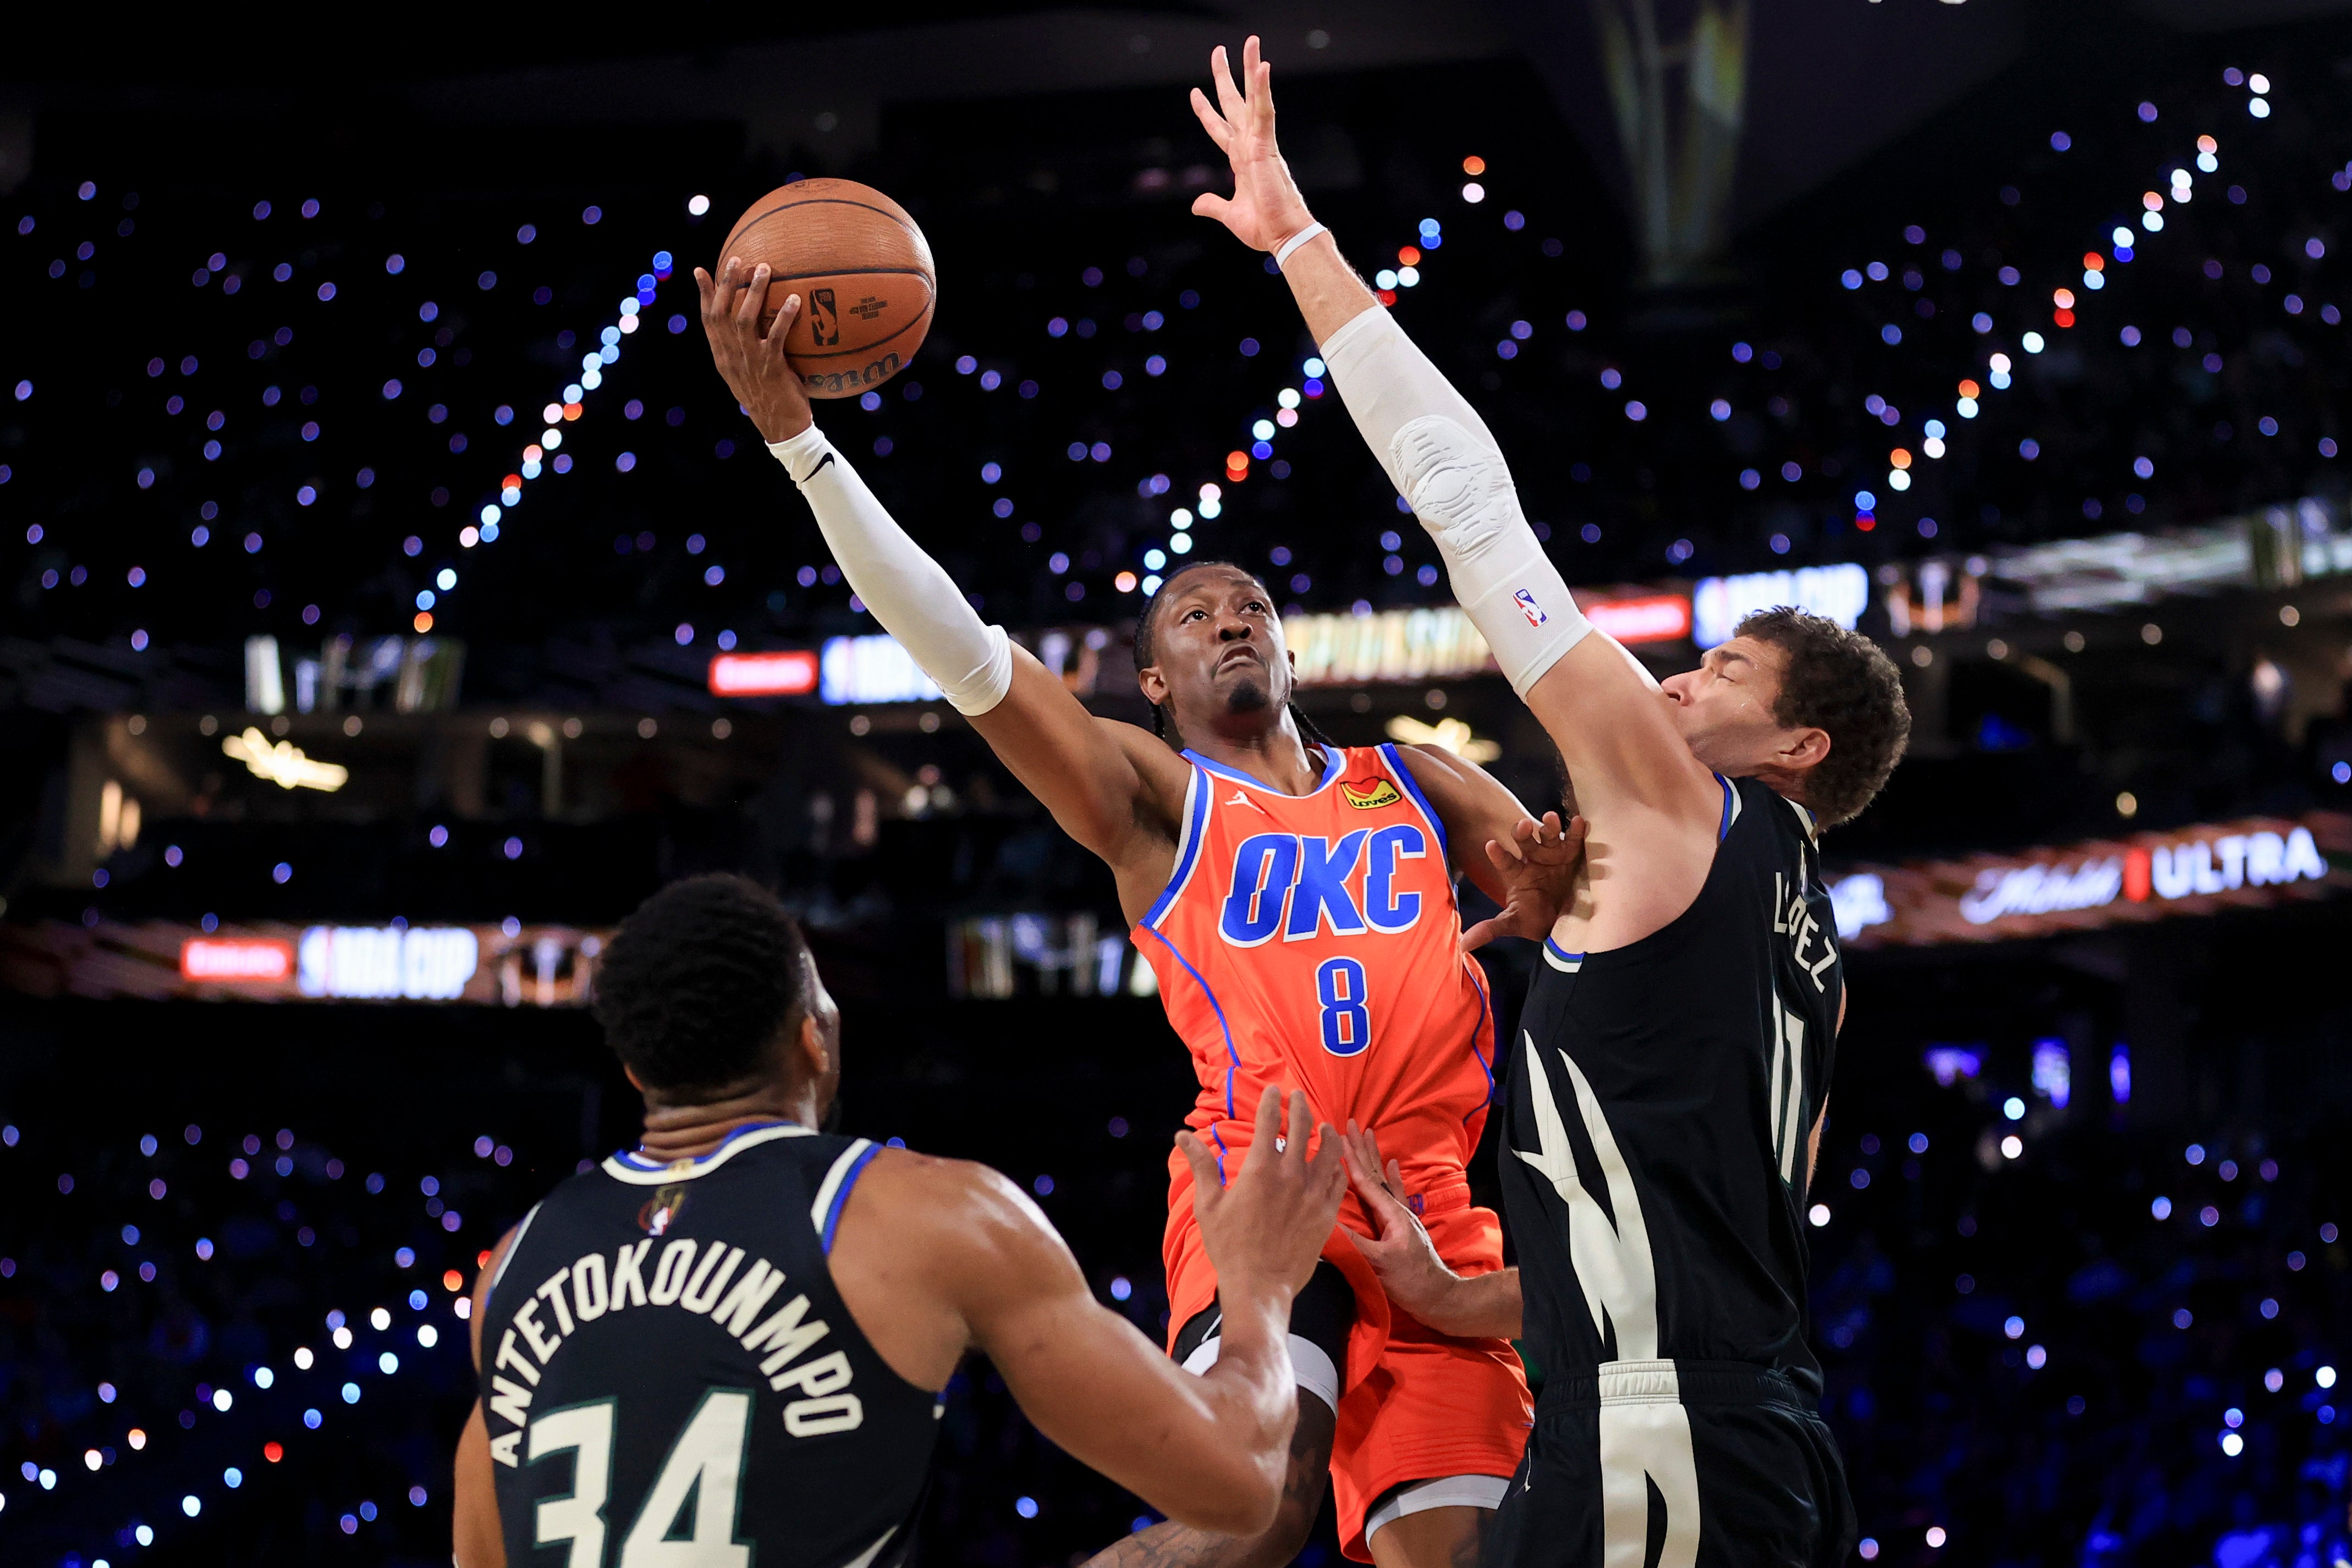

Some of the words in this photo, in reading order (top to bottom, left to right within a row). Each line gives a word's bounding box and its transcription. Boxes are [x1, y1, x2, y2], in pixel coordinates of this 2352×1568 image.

[800, 351, 902, 393] Wils
[1217, 823, 1426, 949] OKC
[2152, 827, 2328, 900] ULTRA
[1773, 871, 1837, 994] LPEZ
[1315, 956, 1371, 1057] 8
[490, 1237, 864, 1468] ANTETOKOUNMPO
[524, 1387, 757, 1568] 34
